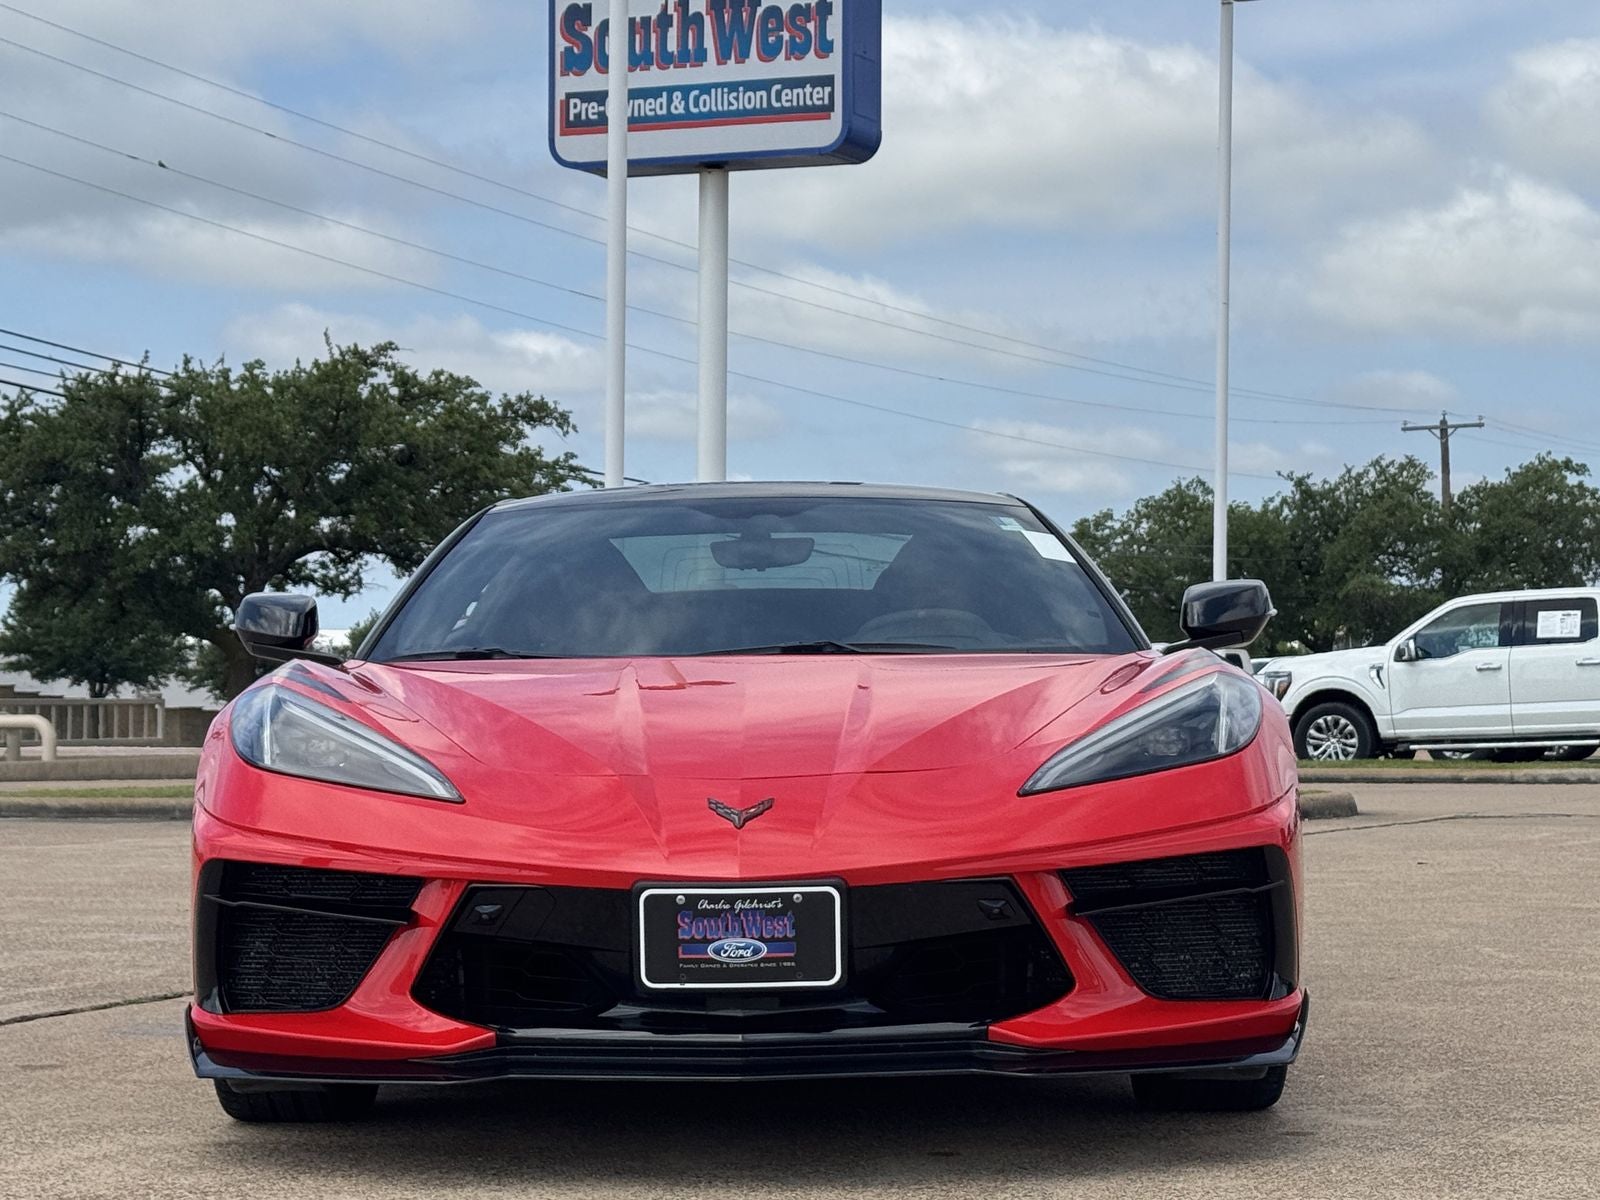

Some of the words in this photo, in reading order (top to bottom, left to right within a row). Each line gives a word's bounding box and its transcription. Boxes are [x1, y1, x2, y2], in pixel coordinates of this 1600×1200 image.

[670, 91, 685, 114] &
[688, 85, 769, 112] Collision
[773, 83, 832, 108] Center
[697, 898, 731, 910] Charlie
[734, 897, 783, 914] Gilchrist's
[720, 942, 753, 957] Ford
